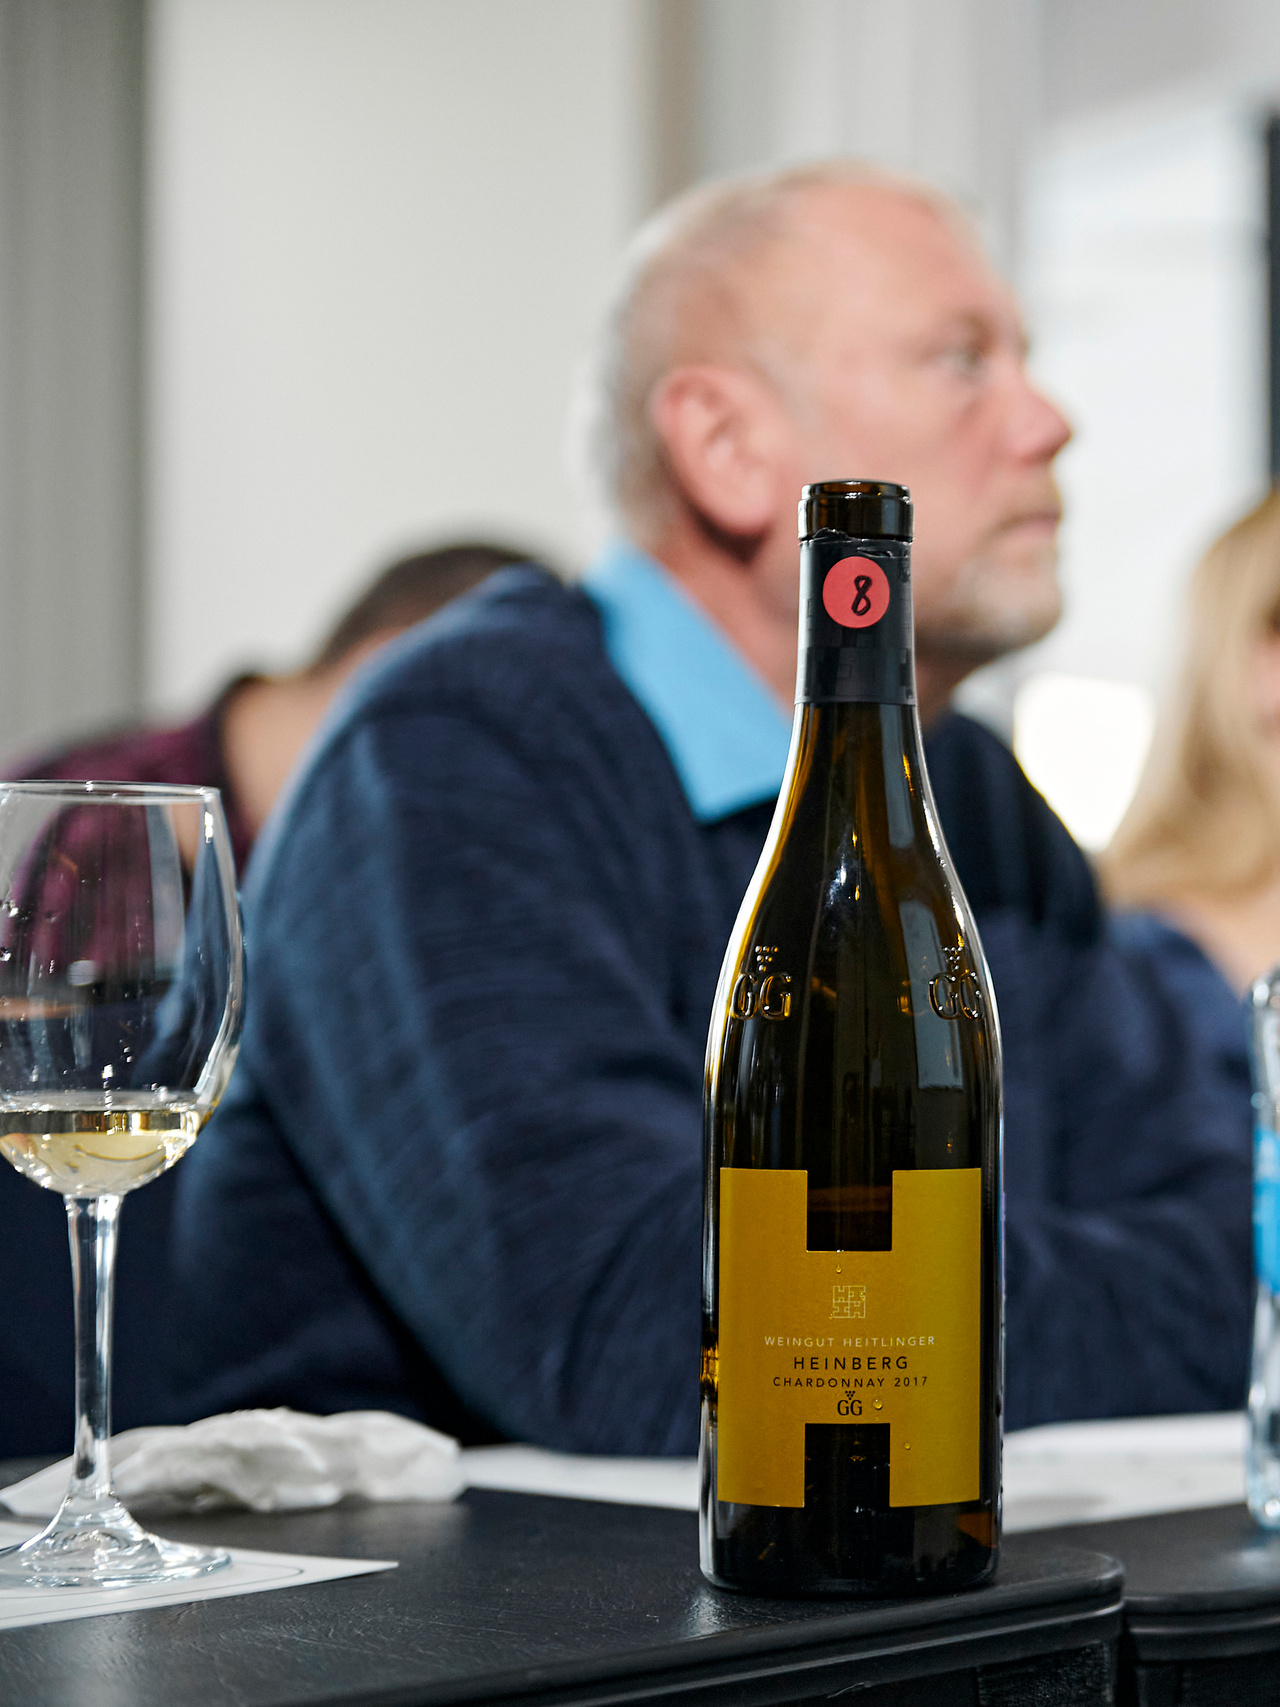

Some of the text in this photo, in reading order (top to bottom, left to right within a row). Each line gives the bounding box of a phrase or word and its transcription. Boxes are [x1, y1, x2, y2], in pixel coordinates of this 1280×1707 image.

[851, 575, 872, 616] 8
[731, 972, 792, 1021] GG
[764, 1335, 935, 1348] WEINGUT HEITLINGER
[793, 1356, 908, 1370] HEINBERG
[773, 1376, 928, 1388] CHARDONNAY 2017
[837, 1399, 862, 1416] GG
